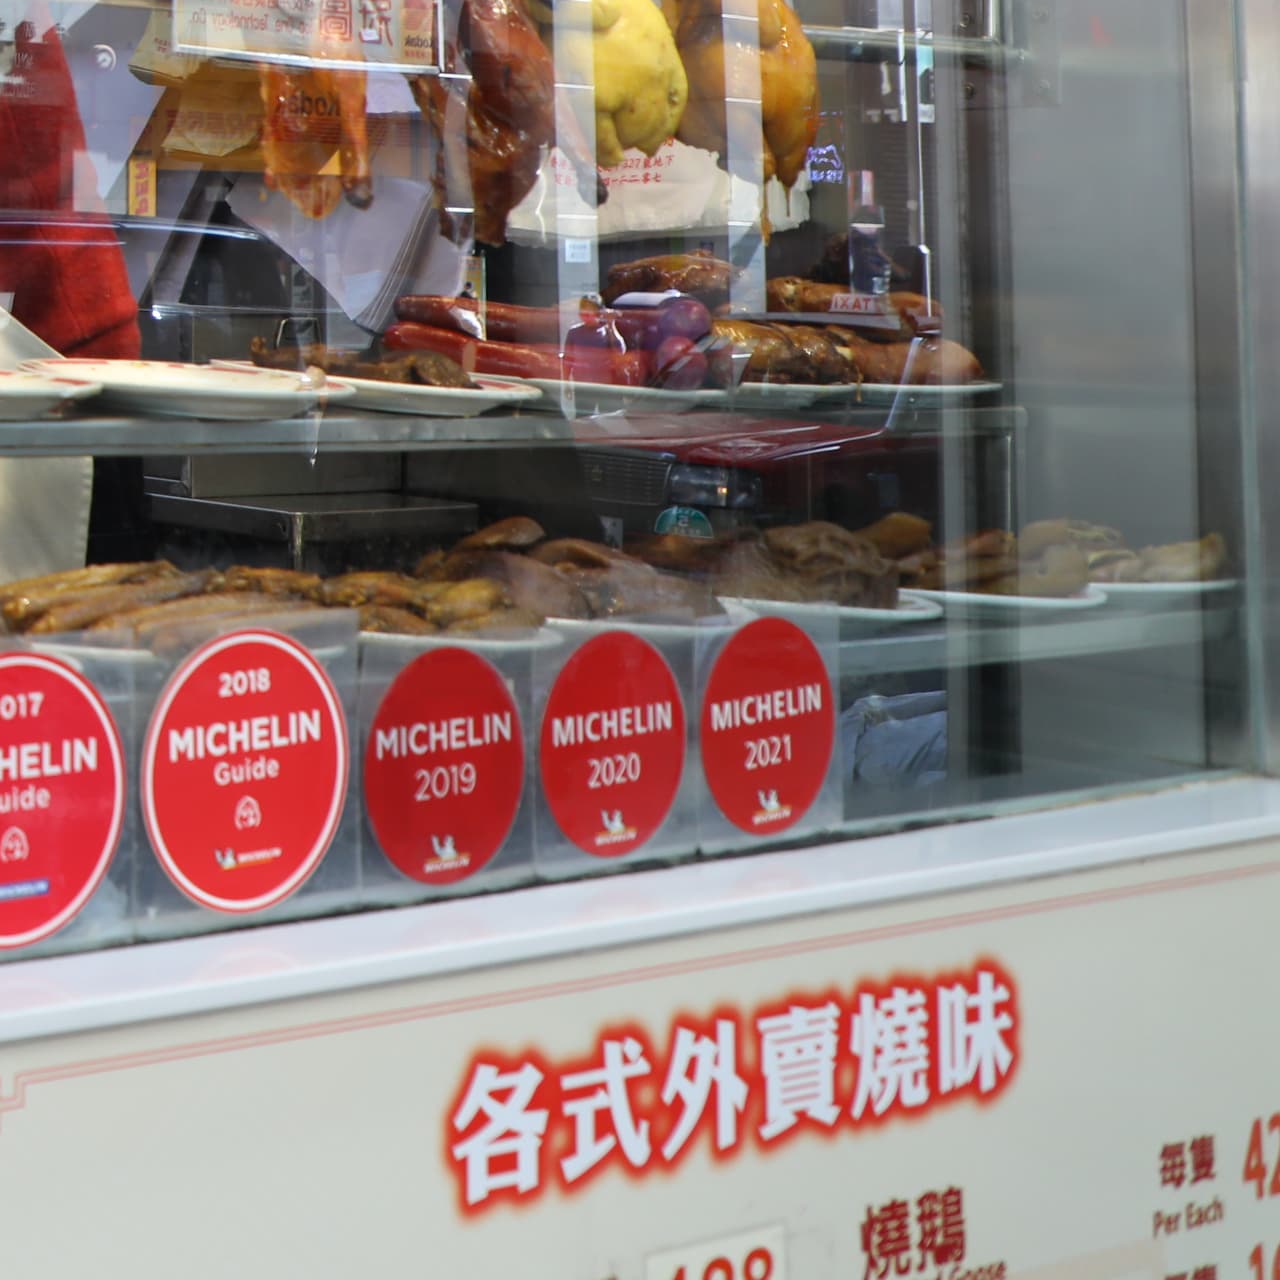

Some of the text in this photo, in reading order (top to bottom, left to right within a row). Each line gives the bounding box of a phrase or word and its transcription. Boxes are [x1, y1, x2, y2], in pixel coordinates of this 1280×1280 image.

[218, 667, 272, 698] 2018
[552, 701, 674, 748] MICHELIN
[710, 683, 823, 733] MICHELIN
[168, 709, 322, 764] MICHELIN
[375, 711, 512, 761] MICHELIN
[744, 734, 793, 770] 2021
[213, 756, 280, 787] Guide
[414, 762, 477, 803] 2019
[587, 751, 641, 790] 2020
[448, 968, 1018, 1210] 各式外賣燒味
[1153, 1196, 1225, 1240] Per Each
